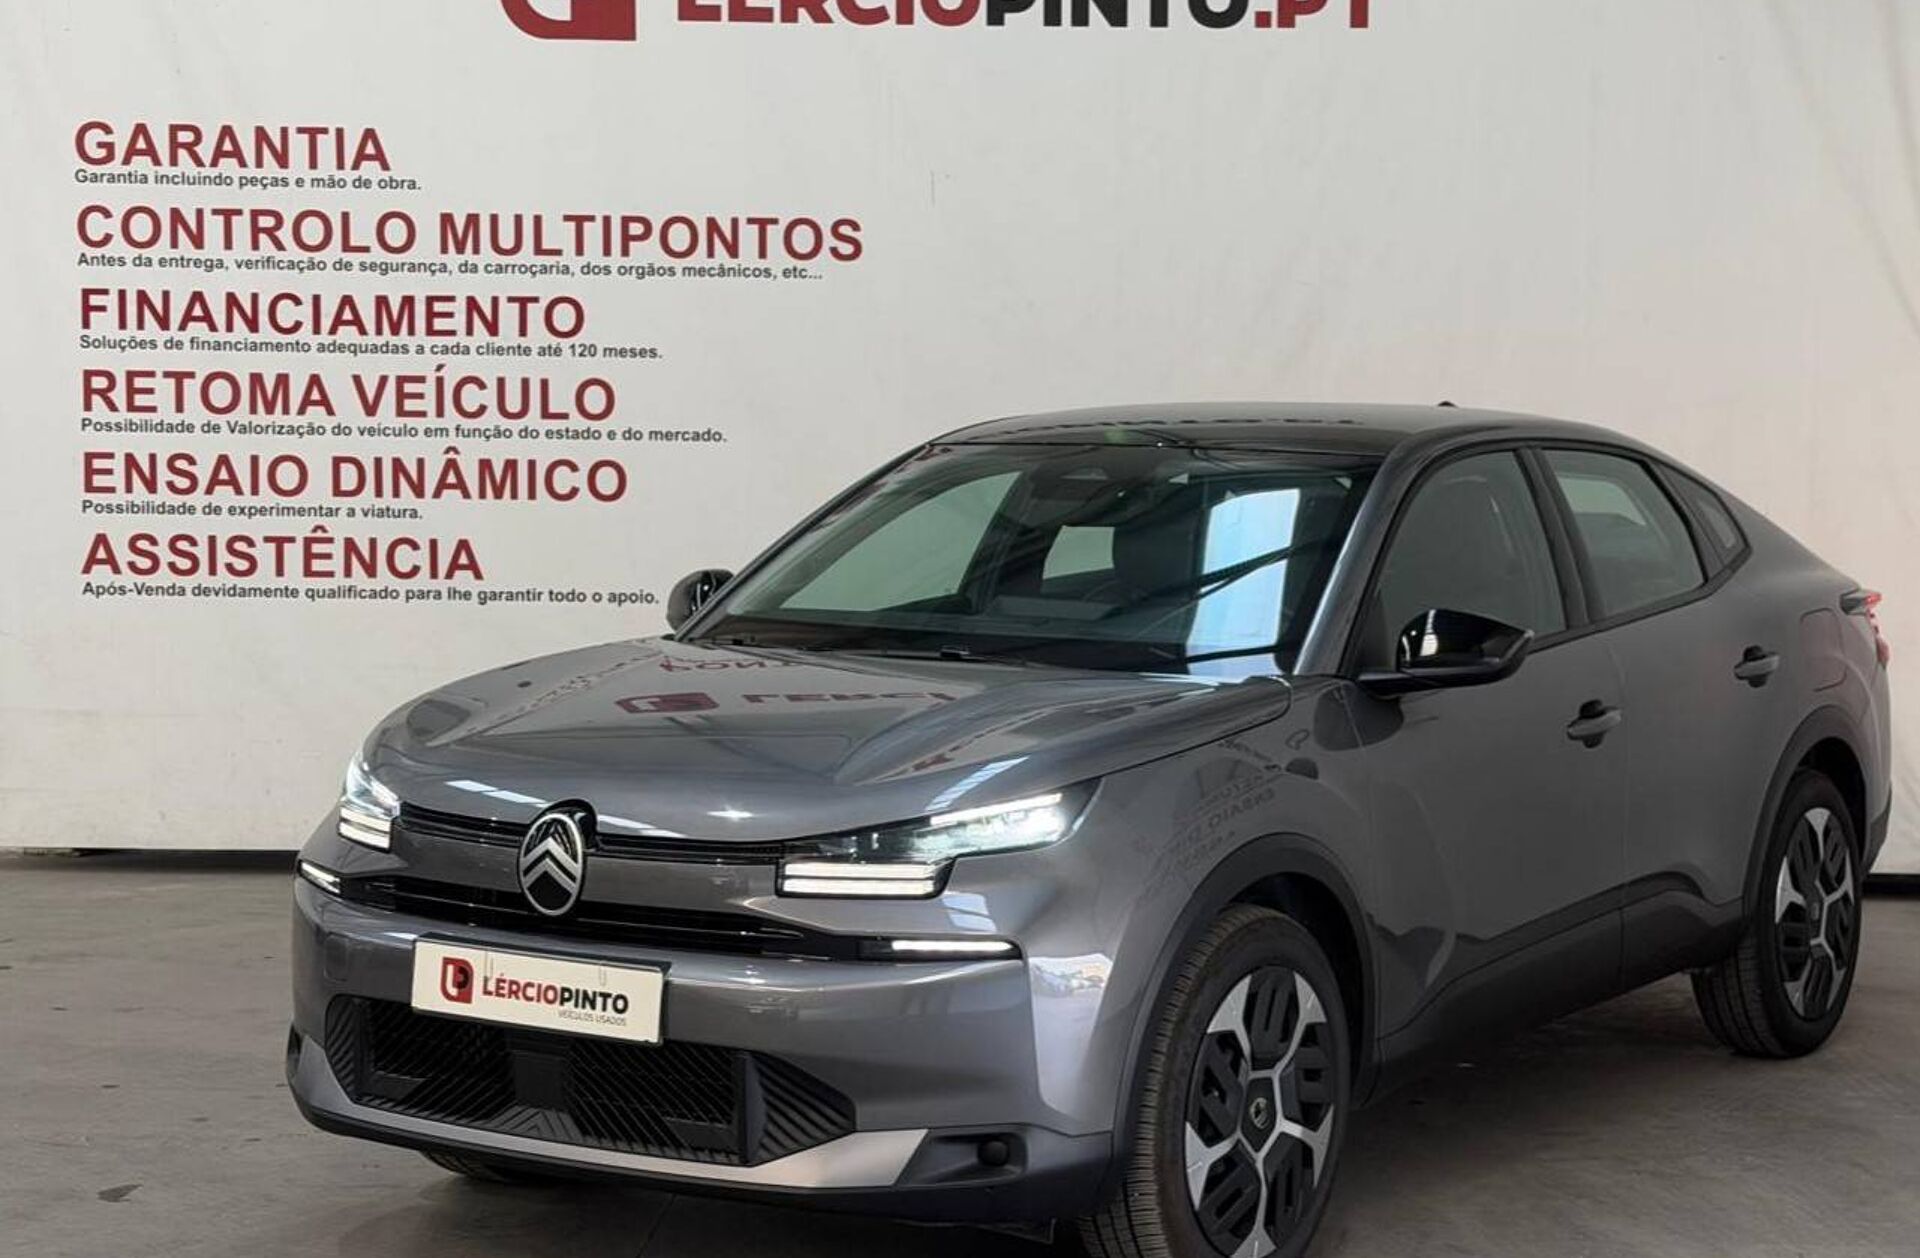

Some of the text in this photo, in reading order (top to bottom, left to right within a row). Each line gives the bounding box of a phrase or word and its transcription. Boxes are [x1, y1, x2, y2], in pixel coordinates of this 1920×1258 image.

[75, 121, 391, 171] GARANTIA
[74, 168, 422, 191] Garantia incluindo peças e mão de obra.
[77, 205, 862, 261] CONTROLO MULTIPONTOS
[77, 252, 822, 281] Antes da entrega, verificação de segurança, da carroçaria, dos orgãos mecânicos, etc...
[81, 288, 584, 339] FINANCIAMENTO
[79, 334, 663, 359] Soluções de financiamento adequadas a cada cliente até 120 meses.
[83, 364, 615, 421] RETOMA VEÍCULO
[81, 417, 727, 443] Possibilidade de Valorização do veículo em função do estado e do mercado.
[84, 447, 627, 502] ENSAIO DINÂMICO
[81, 499, 423, 520] Possibilidade de experimentar a viatura.
[81, 525, 484, 580] ASSISTÊNCIA
[81, 581, 659, 608] Após-Venda devidamente qualificado para lhe garantir todo o apoio.
[482, 973, 629, 1014] LÉRCIOPINTO
